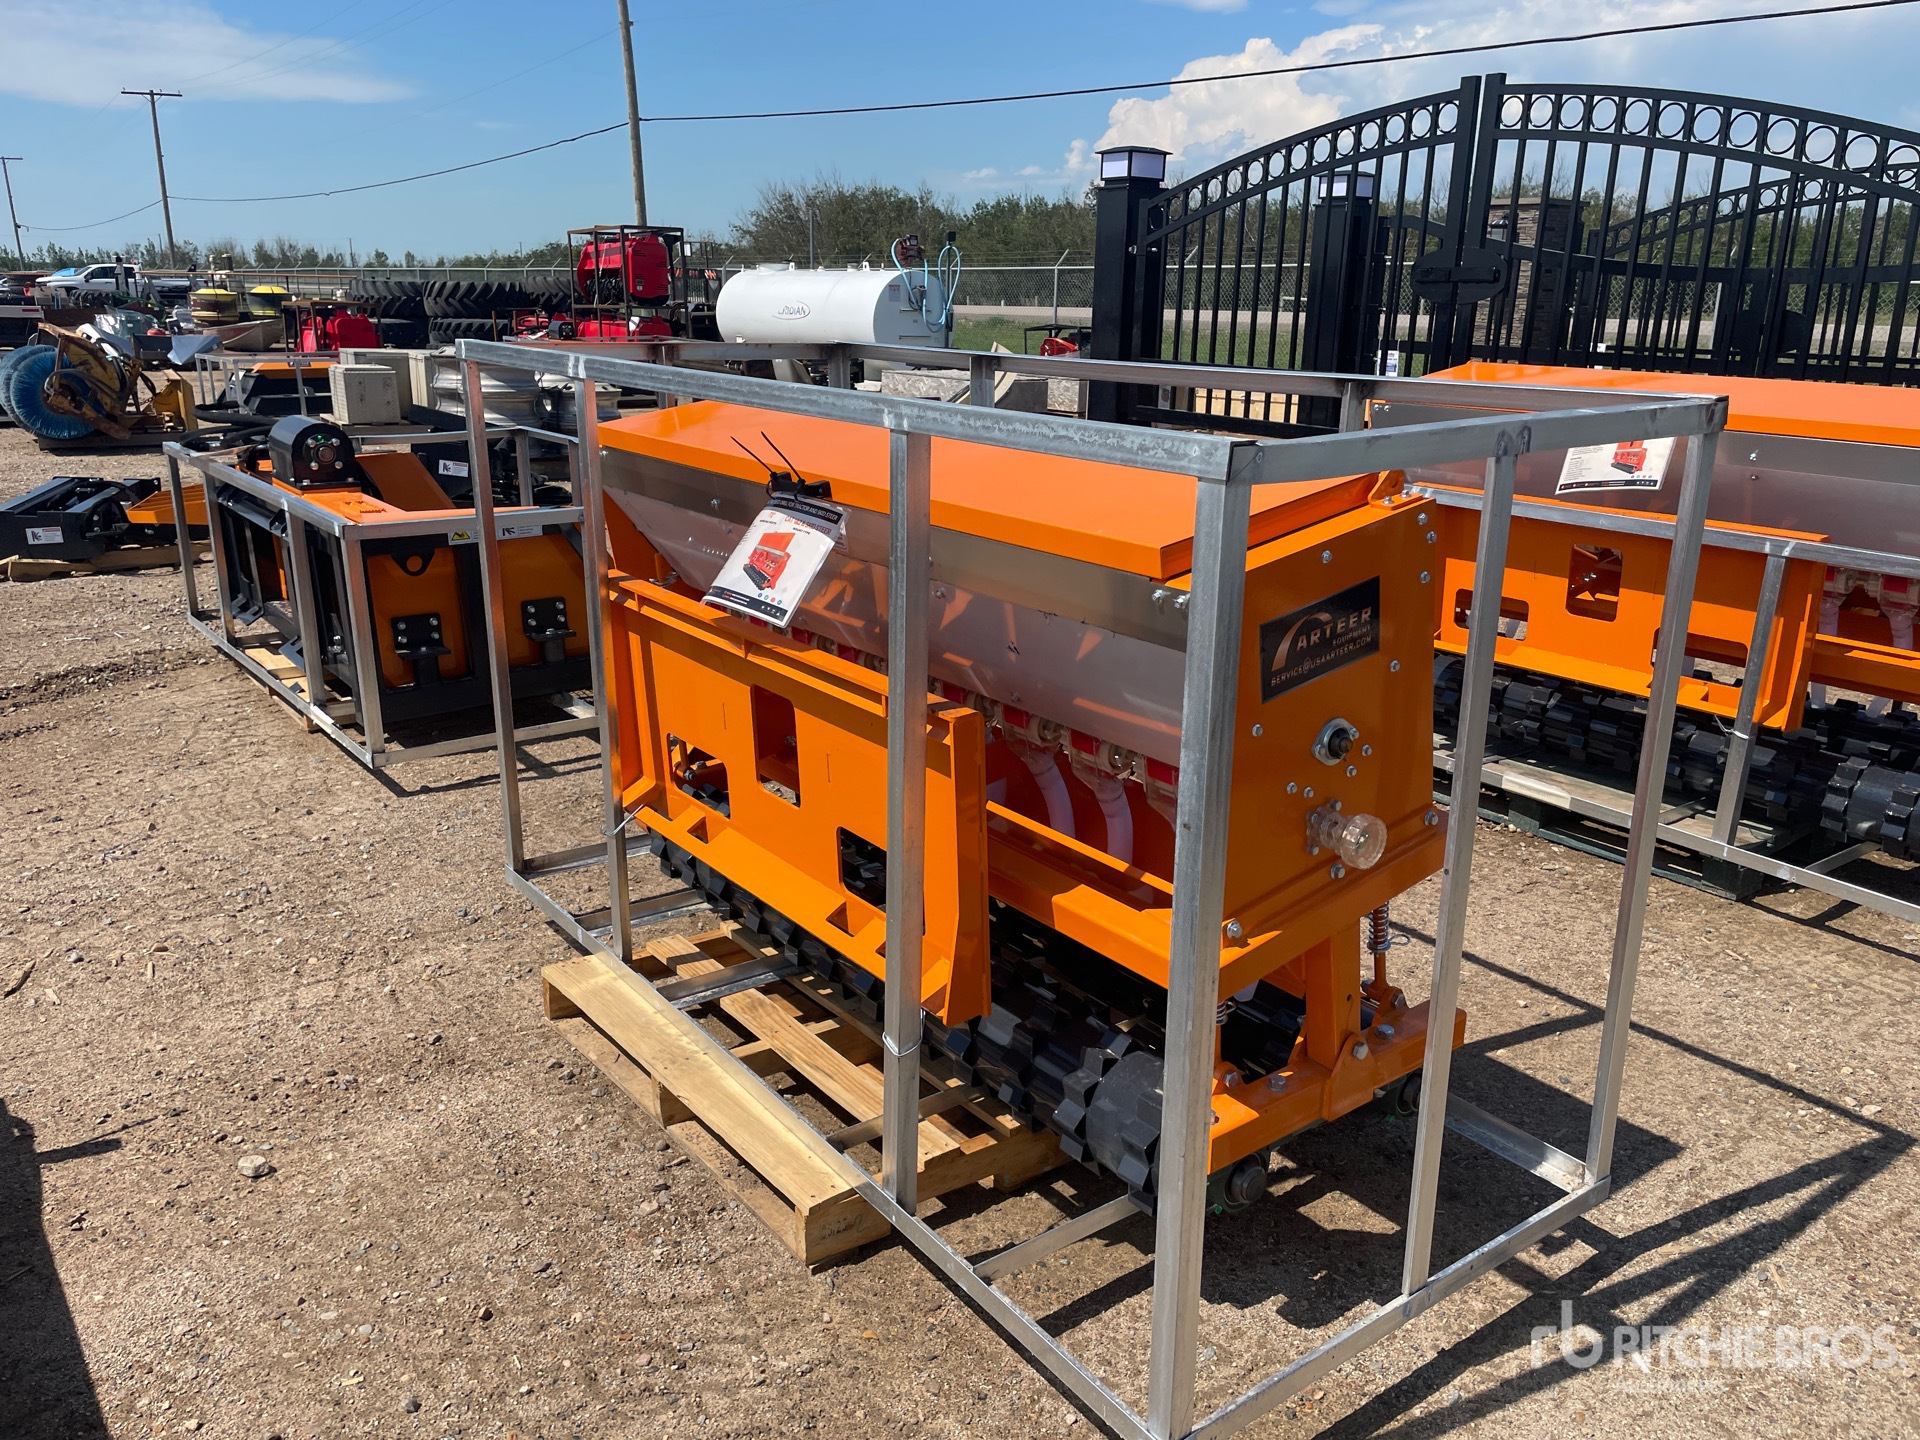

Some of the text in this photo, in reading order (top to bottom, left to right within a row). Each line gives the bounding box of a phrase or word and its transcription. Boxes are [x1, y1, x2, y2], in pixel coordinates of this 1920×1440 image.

[1296, 606, 1372, 652] ARTEER
[1332, 625, 1371, 647] EQUIPMENT
[1271, 634, 1372, 687] SERVICE@USAARTEER.COM
